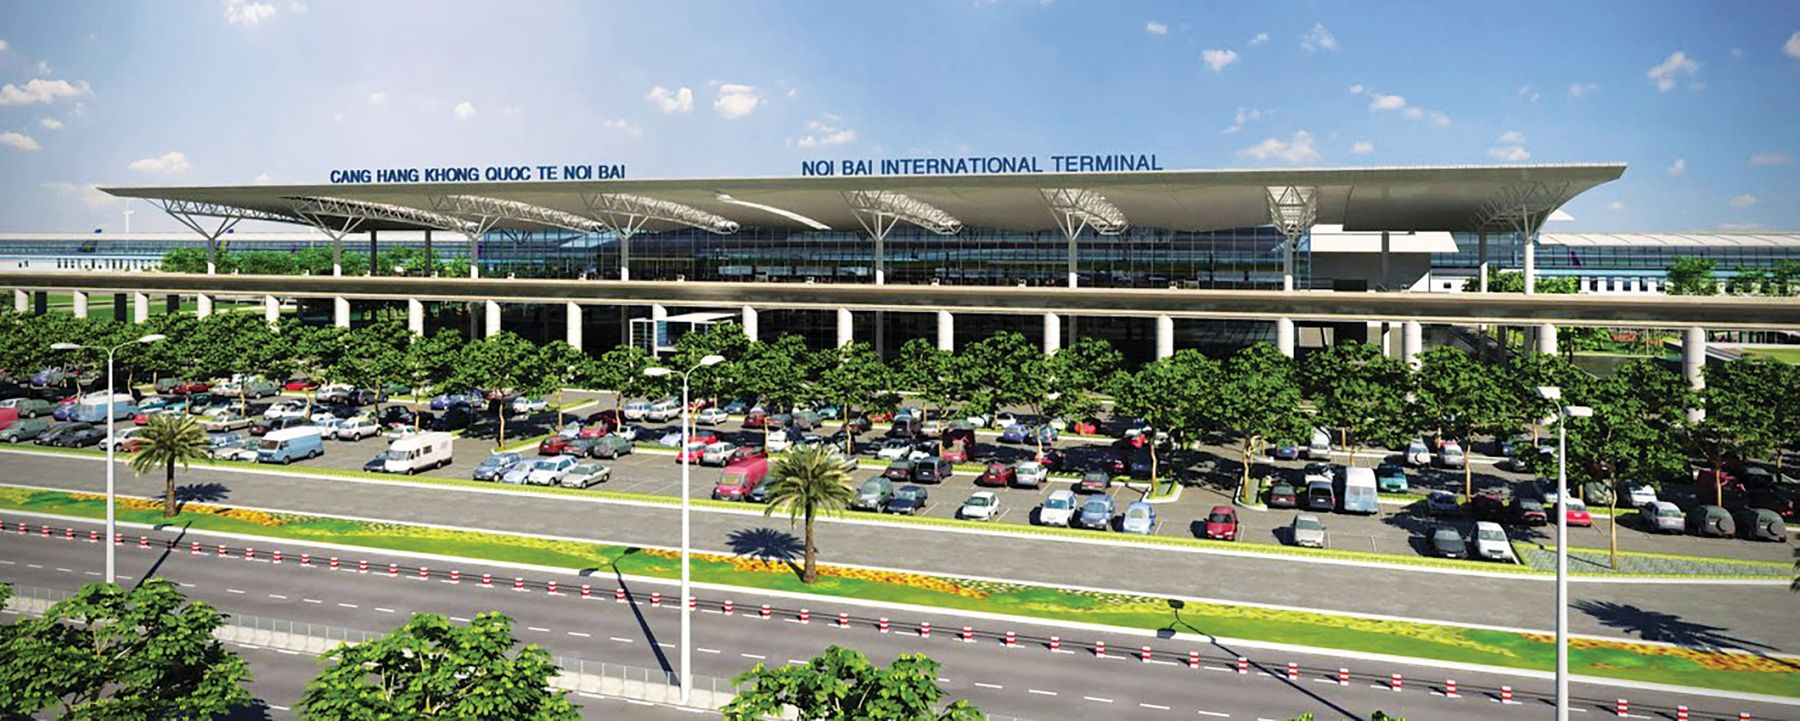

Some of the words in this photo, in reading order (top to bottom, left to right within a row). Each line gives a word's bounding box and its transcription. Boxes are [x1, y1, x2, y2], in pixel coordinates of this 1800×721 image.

[331, 170, 371, 183] CANG
[377, 169, 419, 182] HANG
[425, 168, 479, 181] KHONG
[486, 167, 530, 180] QUOC
[538, 166, 557, 179] TE
[564, 166, 591, 179] NOI
[599, 165, 625, 179] BAI
[803, 161, 833, 175] NOI
[842, 160, 872, 175] BAI
[881, 157, 1043, 174] INTERNATIONAL
[1051, 154, 1163, 172] TERMINAL
